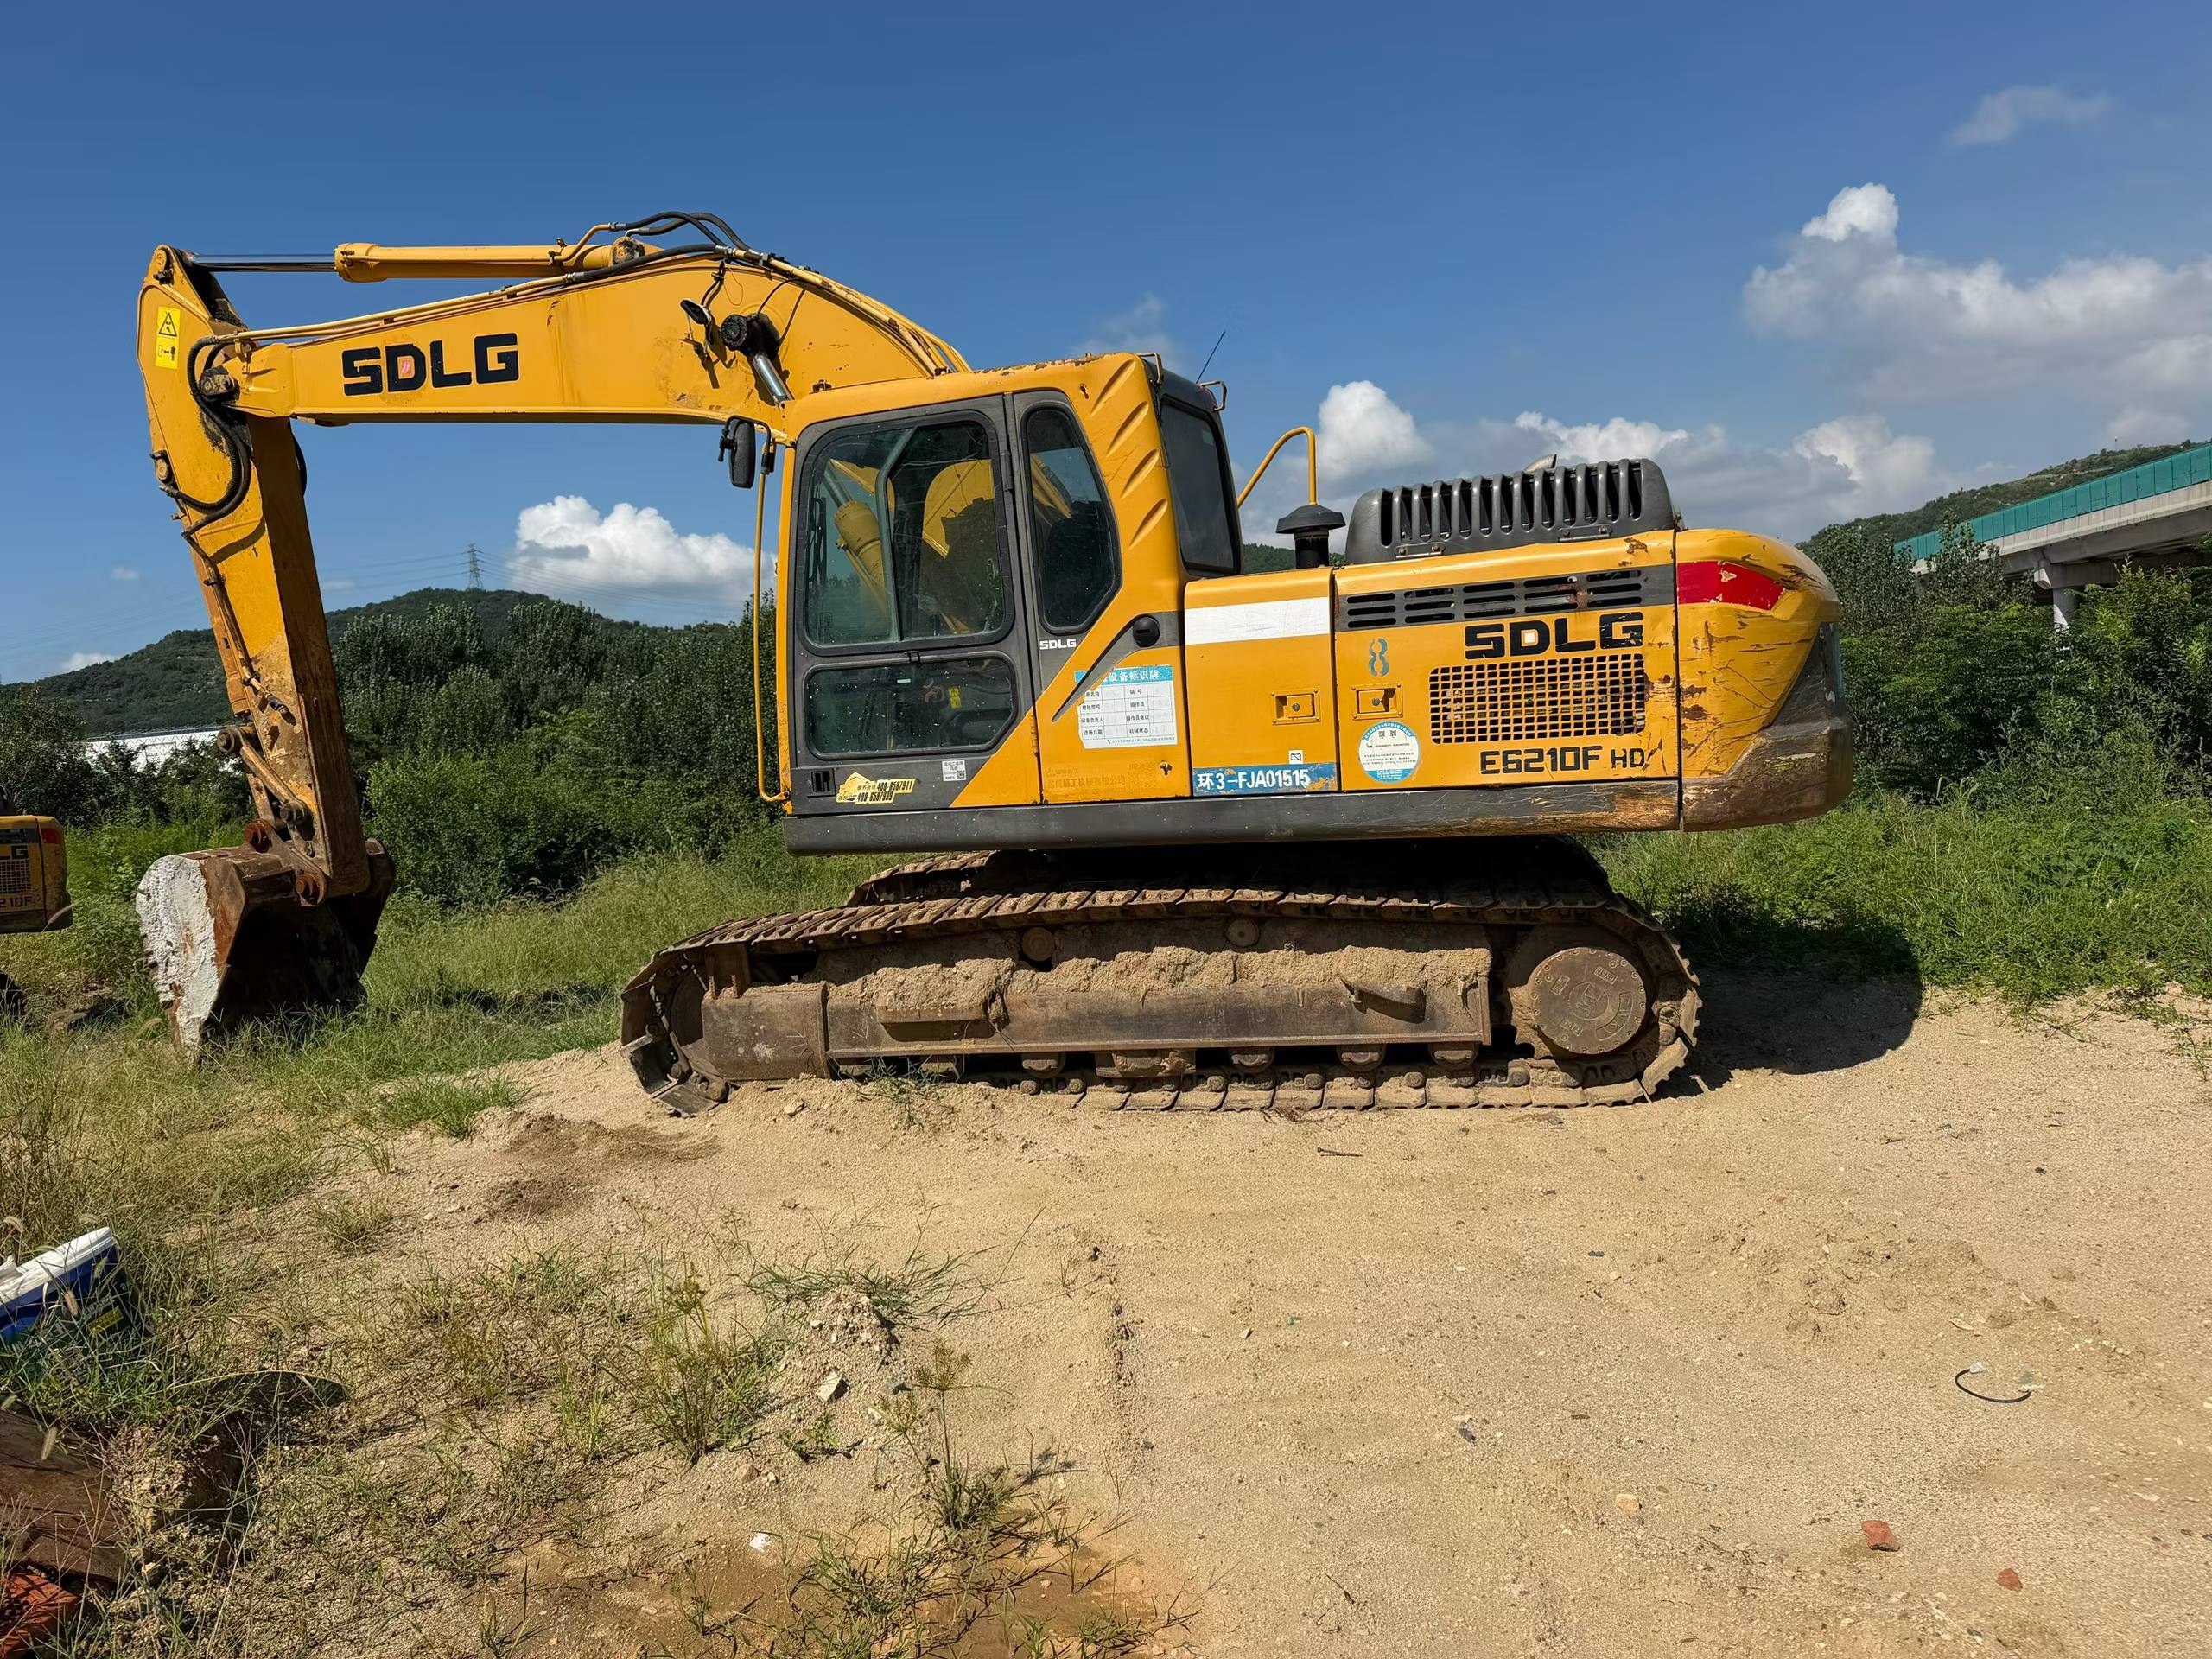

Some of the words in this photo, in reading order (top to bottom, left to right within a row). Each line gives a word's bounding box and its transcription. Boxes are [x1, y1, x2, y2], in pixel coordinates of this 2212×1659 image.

[342, 333, 518, 396] SDLG
[1039, 639, 1076, 650] SDLG
[1464, 612, 1643, 660] SDLG
[1103, 669, 1160, 683] 设备标识牌
[1480, 746, 1603, 775] E6210F
[1611, 748, 1645, 770] HD
